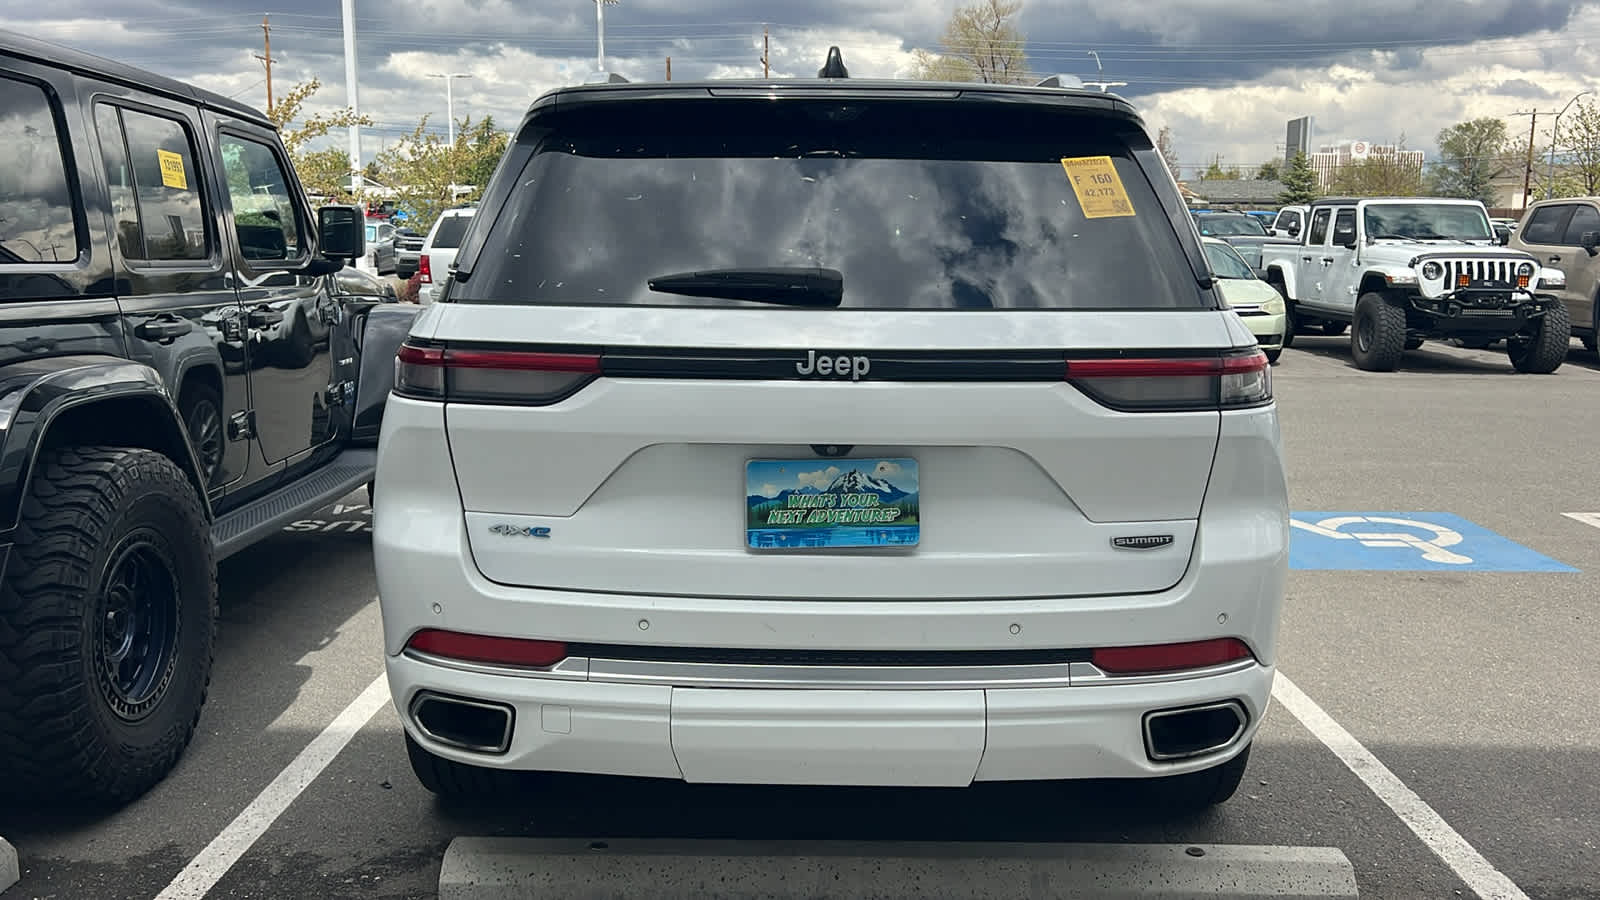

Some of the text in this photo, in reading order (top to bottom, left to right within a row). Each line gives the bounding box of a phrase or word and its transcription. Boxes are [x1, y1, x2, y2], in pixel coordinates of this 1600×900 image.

[1090, 173, 1113, 185] 160
[796, 350, 870, 380] Jeep
[787, 492, 880, 509] WHAT'S YOUR
[767, 508, 901, 525] NEXT ADVENTURE?
[1115, 536, 1172, 545] SUMMIT
